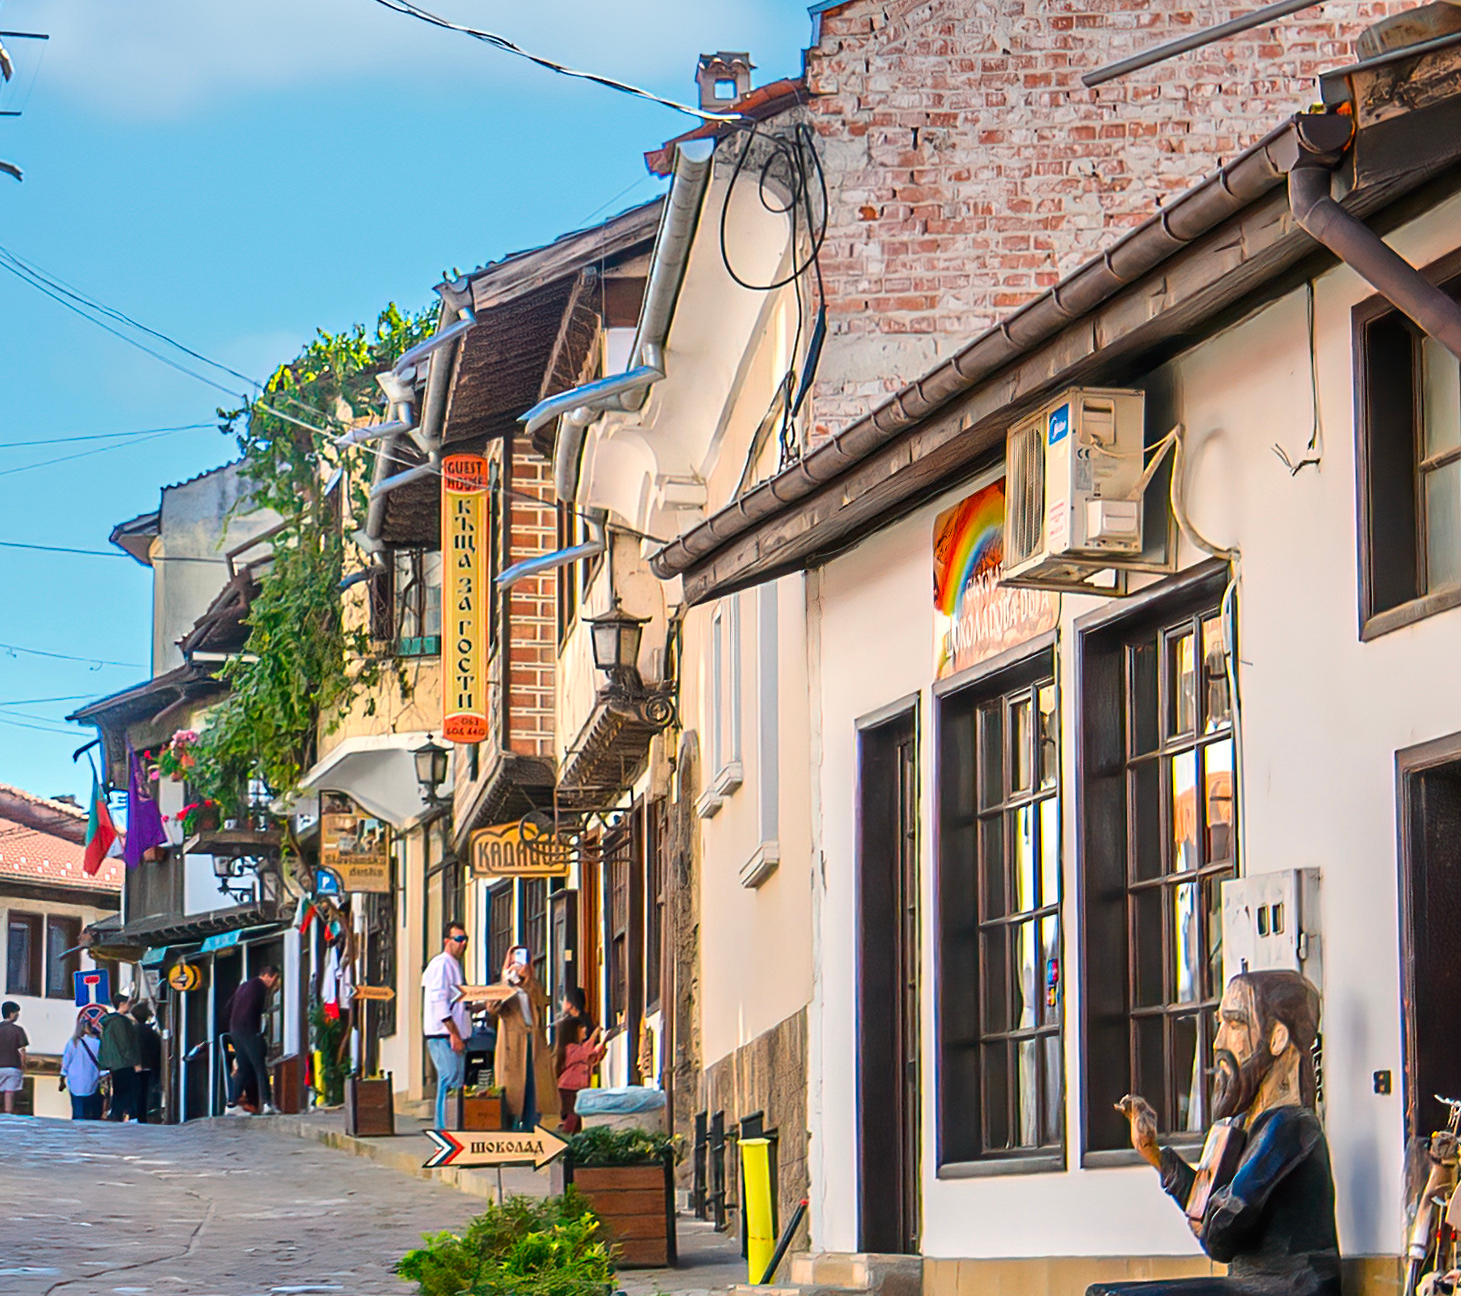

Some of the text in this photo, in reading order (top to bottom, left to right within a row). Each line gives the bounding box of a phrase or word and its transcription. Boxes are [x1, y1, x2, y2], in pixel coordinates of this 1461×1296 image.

[447, 461, 483, 474] GUEST
[454, 499, 475, 568] КЪЩА
[457, 577, 473, 612] ЗА
[469, 1140, 545, 1154] ШОКОЛАД
